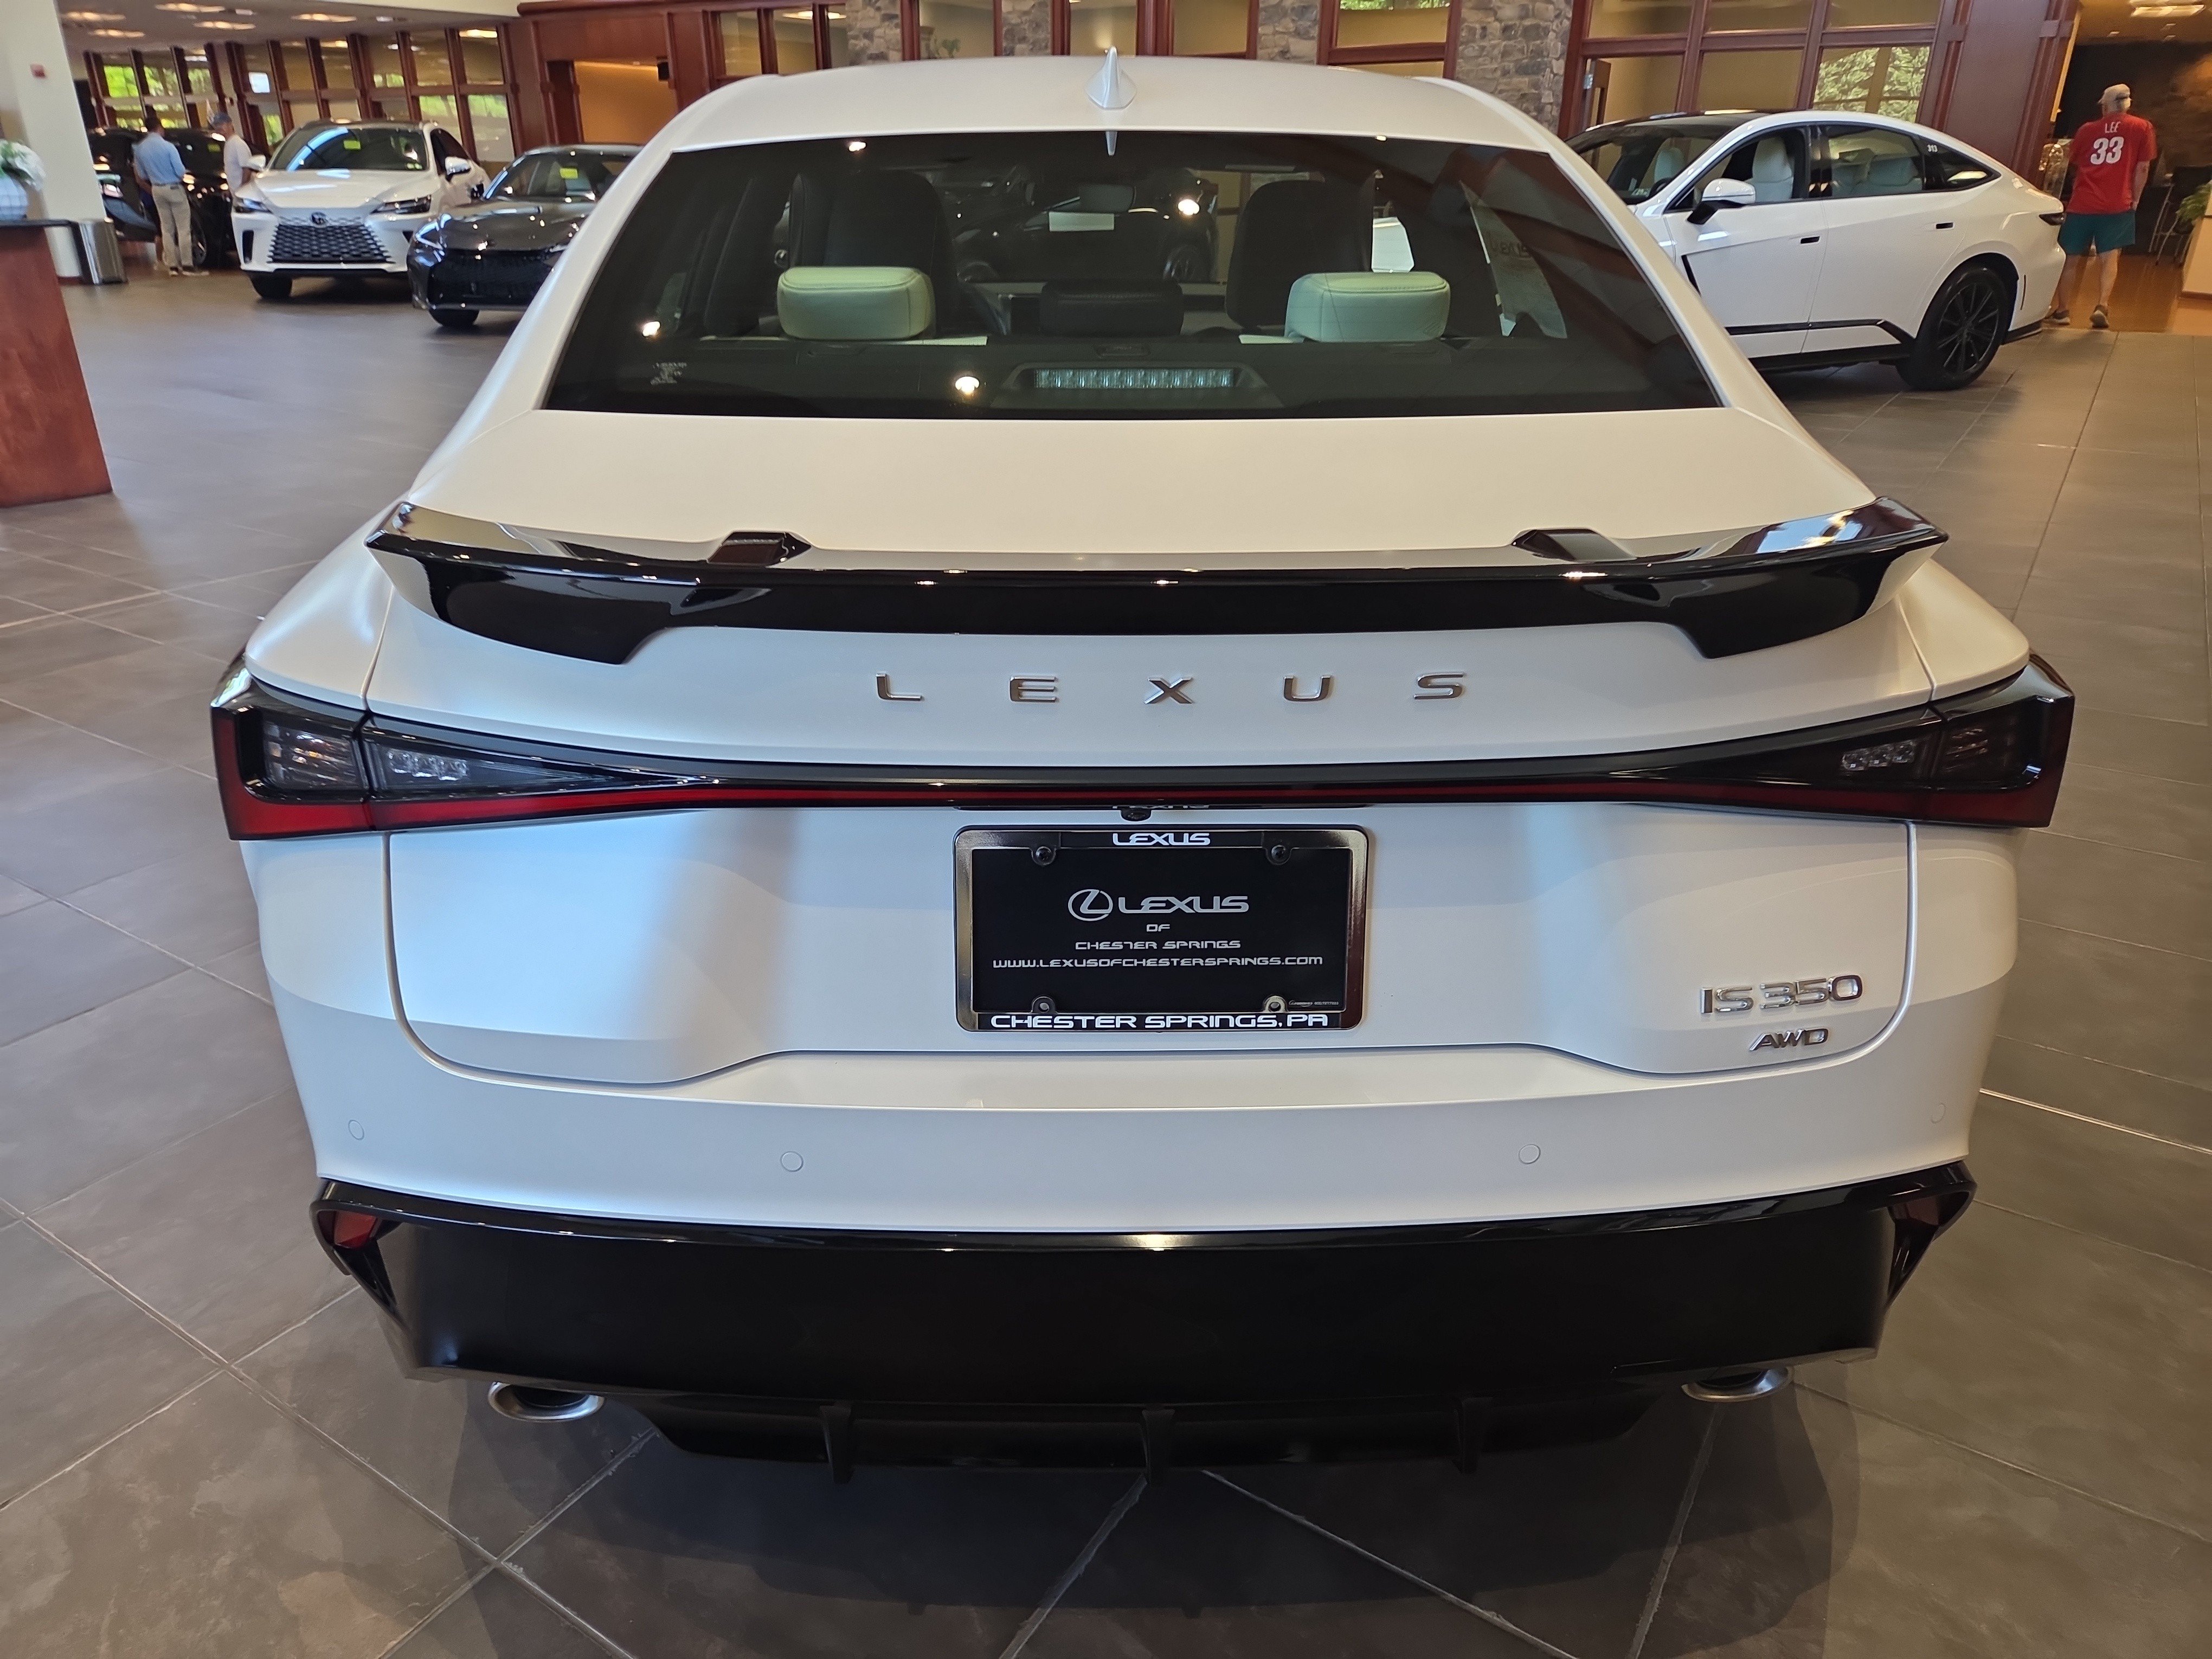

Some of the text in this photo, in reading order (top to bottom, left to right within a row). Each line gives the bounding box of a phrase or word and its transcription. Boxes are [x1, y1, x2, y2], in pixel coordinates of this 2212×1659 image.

[2105, 121, 2121, 133] LEE
[2091, 136, 2125, 165] 33
[876, 672, 1466, 704] LEXUS
[1113, 833, 1211, 846] LEXUS
[1118, 896, 1249, 914] LEXUS
[1146, 924, 1171, 932] OF
[1075, 940, 1241, 950] CHESTER SPRINGS
[1700, 975, 1863, 1014] IS 350
[991, 1014, 1328, 1028] CHESTER SPRINGS, PA
[1749, 1028, 1829, 1052] AWD
